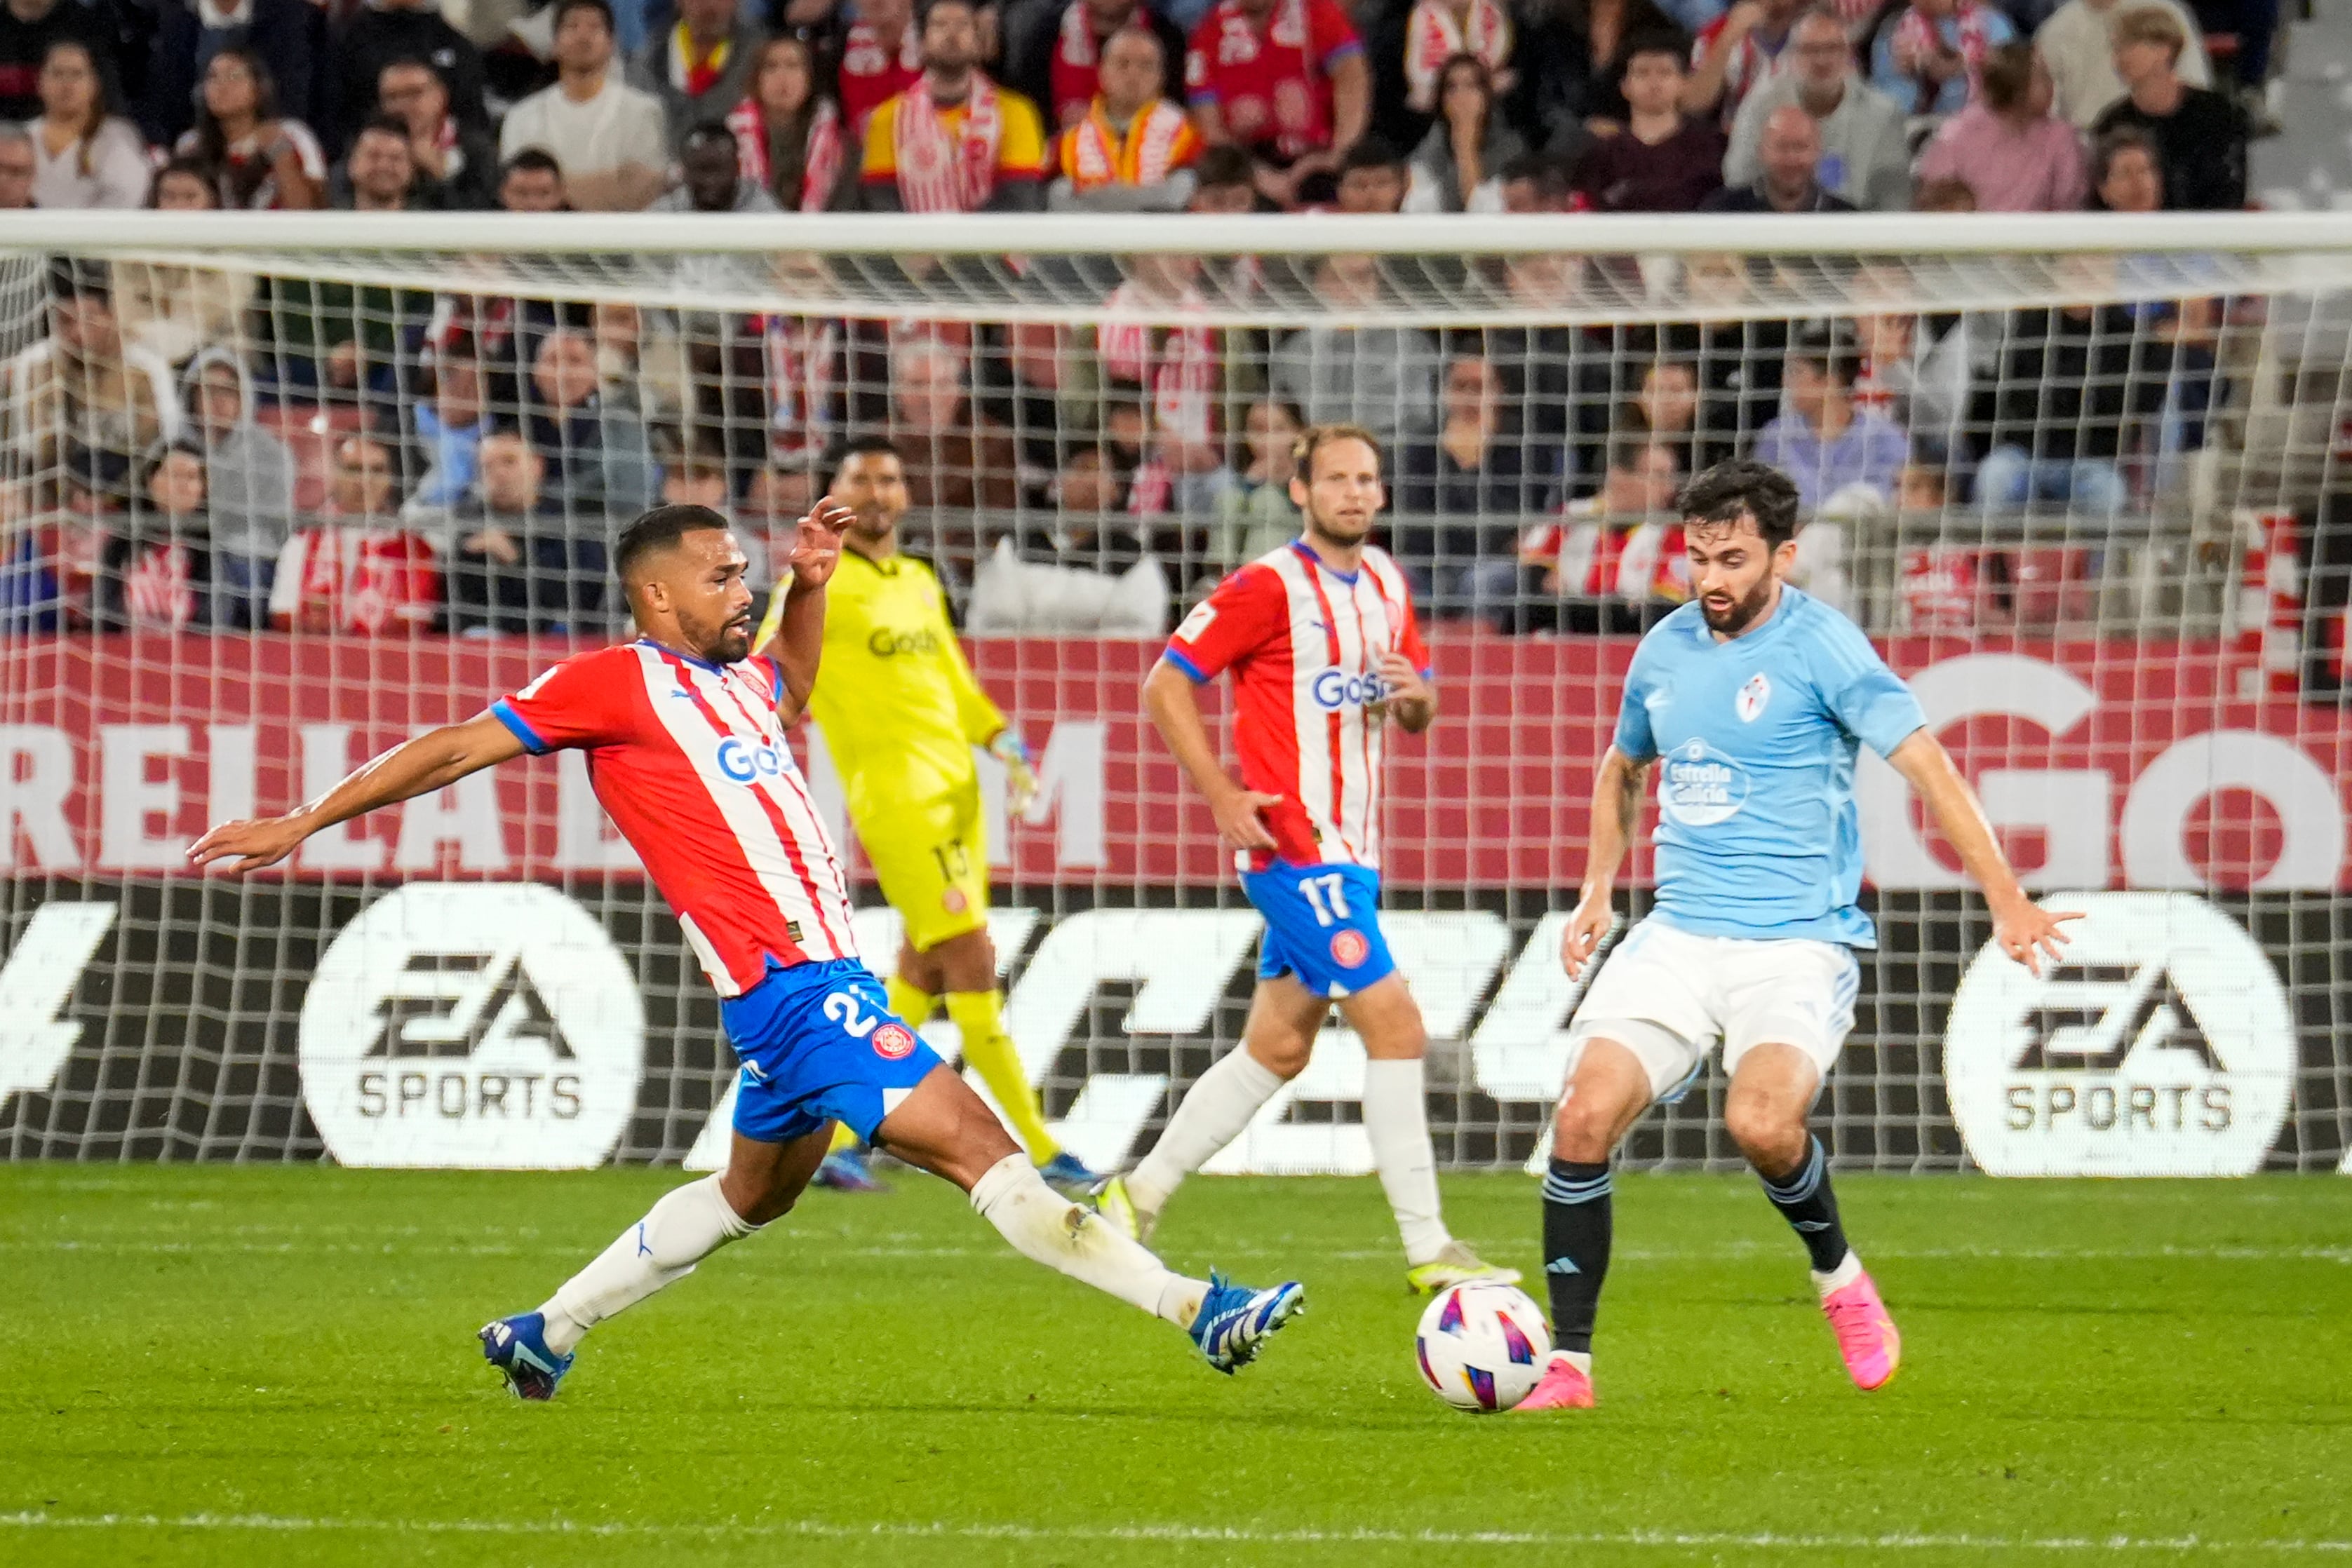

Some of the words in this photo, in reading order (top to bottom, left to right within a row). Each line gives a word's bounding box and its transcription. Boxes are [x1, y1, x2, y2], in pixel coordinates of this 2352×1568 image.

[1312, 670, 1387, 708] Gos
[1298, 872, 1351, 928] 17
[363, 949, 577, 1060] EA
[823, 984, 894, 1038] 2
[2010, 959, 2229, 1073] EA
[357, 1072, 582, 1121] SPORTS
[2005, 1085, 2236, 1132] SPORTS
